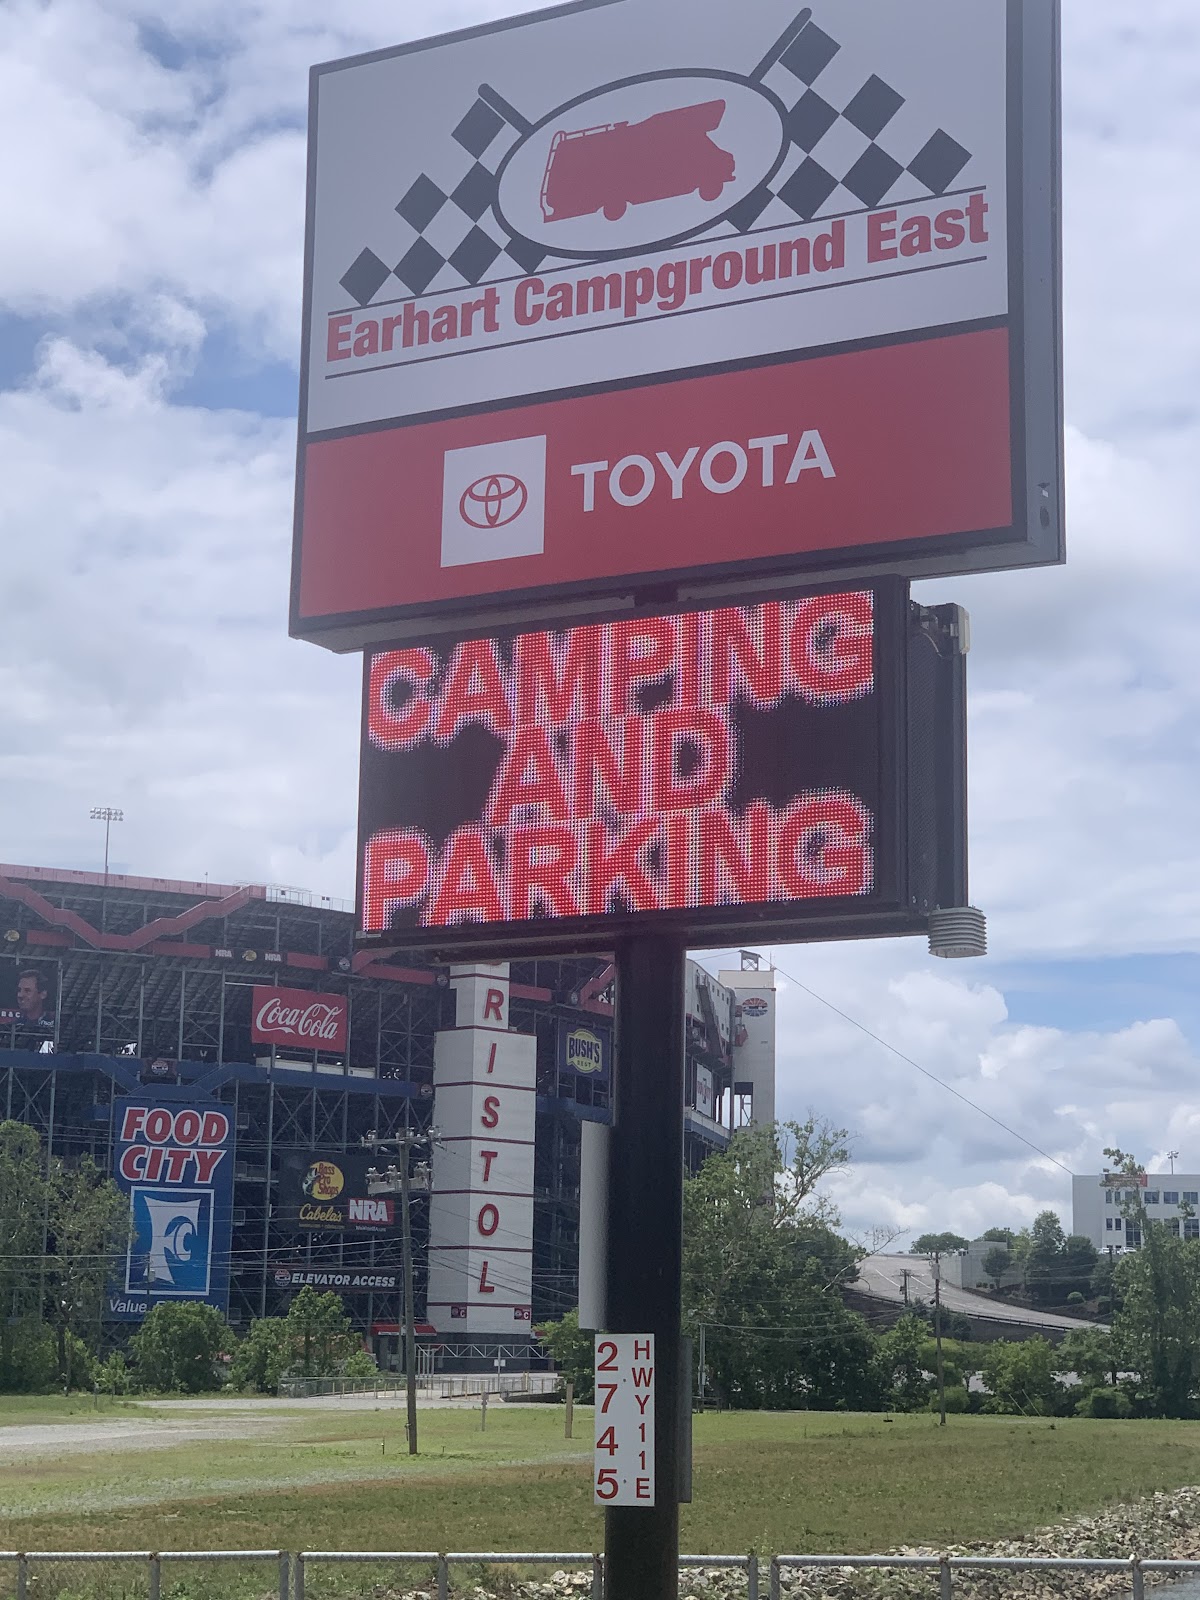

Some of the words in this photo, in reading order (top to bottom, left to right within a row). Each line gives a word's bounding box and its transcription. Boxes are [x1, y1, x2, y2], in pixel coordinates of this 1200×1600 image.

[326, 286, 500, 362] Earhart
[513, 220, 846, 327] Campground
[866, 193, 990, 264] East
[571, 429, 836, 512] TOYOTA
[367, 590, 874, 751] CAMPING
[486, 704, 742, 828] AND
[362, 788, 875, 931] PARKING
[256, 998, 343, 1039] Coca-Cola
[120, 1106, 229, 1146] FOOD
[119, 1144, 227, 1184] CITY
[317, 1174, 332, 1185] Pro
[318, 1163, 336, 1175] Bass
[317, 1183, 340, 1198] Shops
[348, 1199, 389, 1221] NRA
[300, 1203, 342, 1222] Cabela's
[291, 1272, 351, 1286] ELEVATOR
[351, 1275, 396, 1287] ACCESS
[109, 1299, 148, 1313] Value
